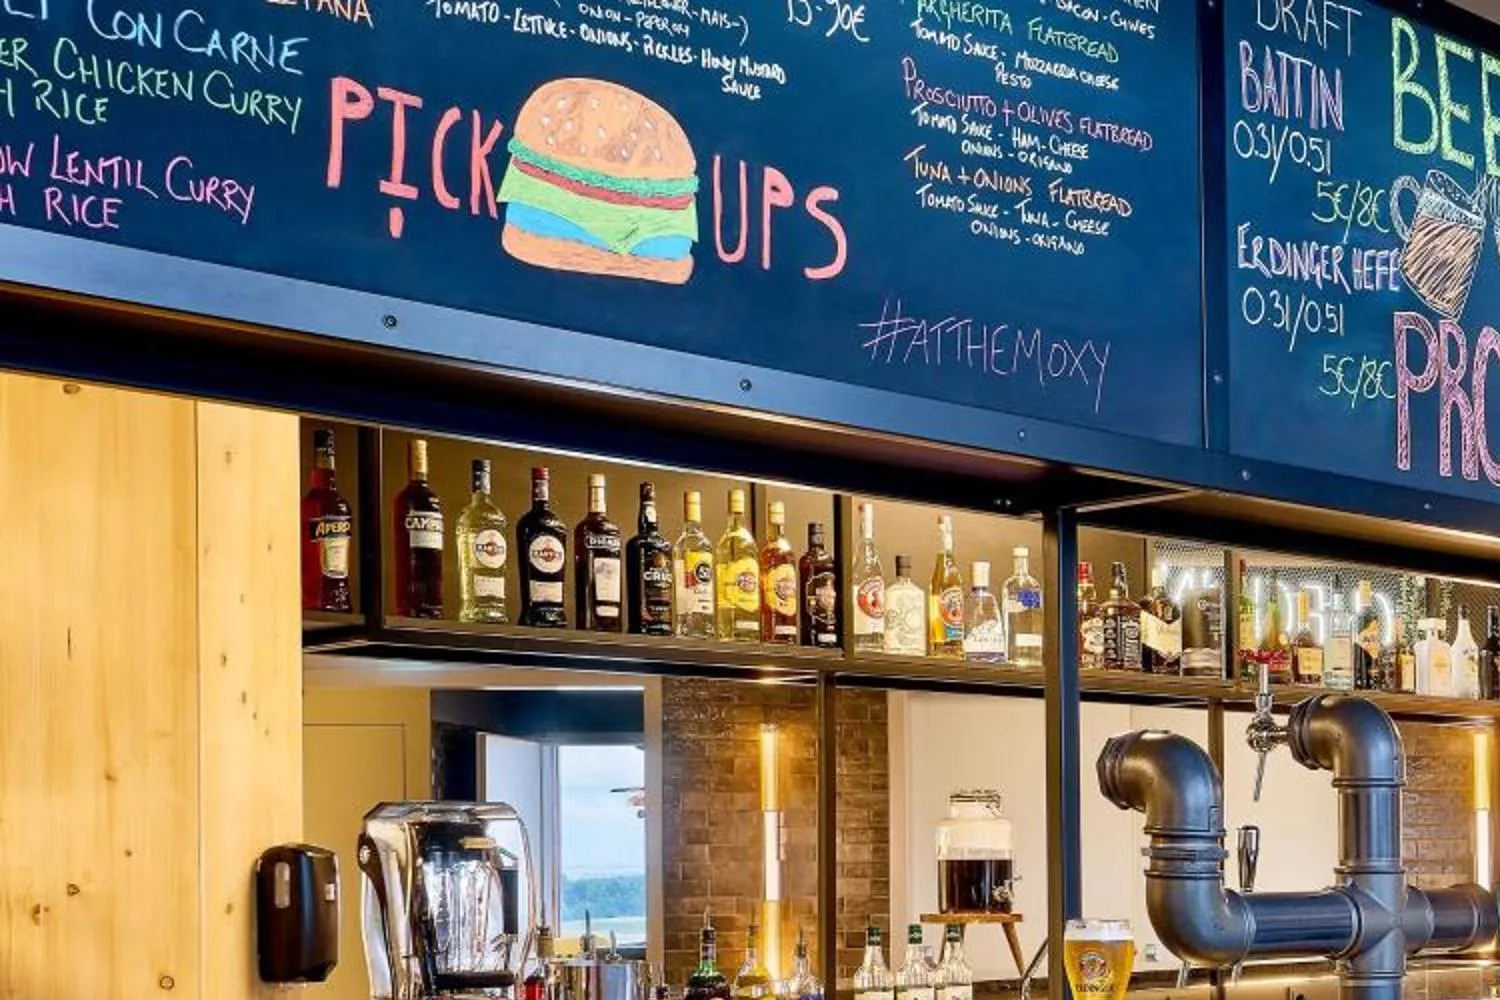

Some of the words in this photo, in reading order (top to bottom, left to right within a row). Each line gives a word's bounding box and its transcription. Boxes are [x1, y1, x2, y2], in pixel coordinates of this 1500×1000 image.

[173, 9, 308, 75] CARNE
[513, 7, 567, 39] LETTUCE
[579, 23, 633, 52] ONIONS
[643, 34, 693, 64] PICKLES
[910, 18, 961, 51] TOMATO
[963, 33, 998, 61] SAUCE
[1027, 17, 1119, 64] FLATBREAD
[1257, 0, 1363, 57] DRAFT
[32, 79, 109, 125] RICE
[53, 37, 194, 101] CHICKEN
[203, 70, 302, 134] CURRY
[721, 76, 762, 100] SAUCE
[994, 60, 1032, 90] PESTO
[1239, 40, 1345, 132] BATTIN
[902, 56, 997, 118] PROSCIUTTO
[1079, 118, 1153, 152] FLATBREAD
[1012, 127, 1041, 151] HAM
[1049, 135, 1089, 160] CHEESE
[50, 133, 159, 199] LENTIL
[166, 156, 255, 225] CURRY
[904, 144, 952, 185] TUNA
[1048, 178, 1133, 218] FLATBREAD
[44, 187, 123, 230] RICE
[713, 154, 848, 280] UPS
[916, 183, 964, 212] TOMATO
[1015, 198, 1049, 227] TUNA
[1065, 211, 1111, 236] CHEESE
[971, 219, 1021, 245] ONIONS
[1237, 222, 1351, 295] ERDINGER
[1352, 247, 1400, 292] HEFE
